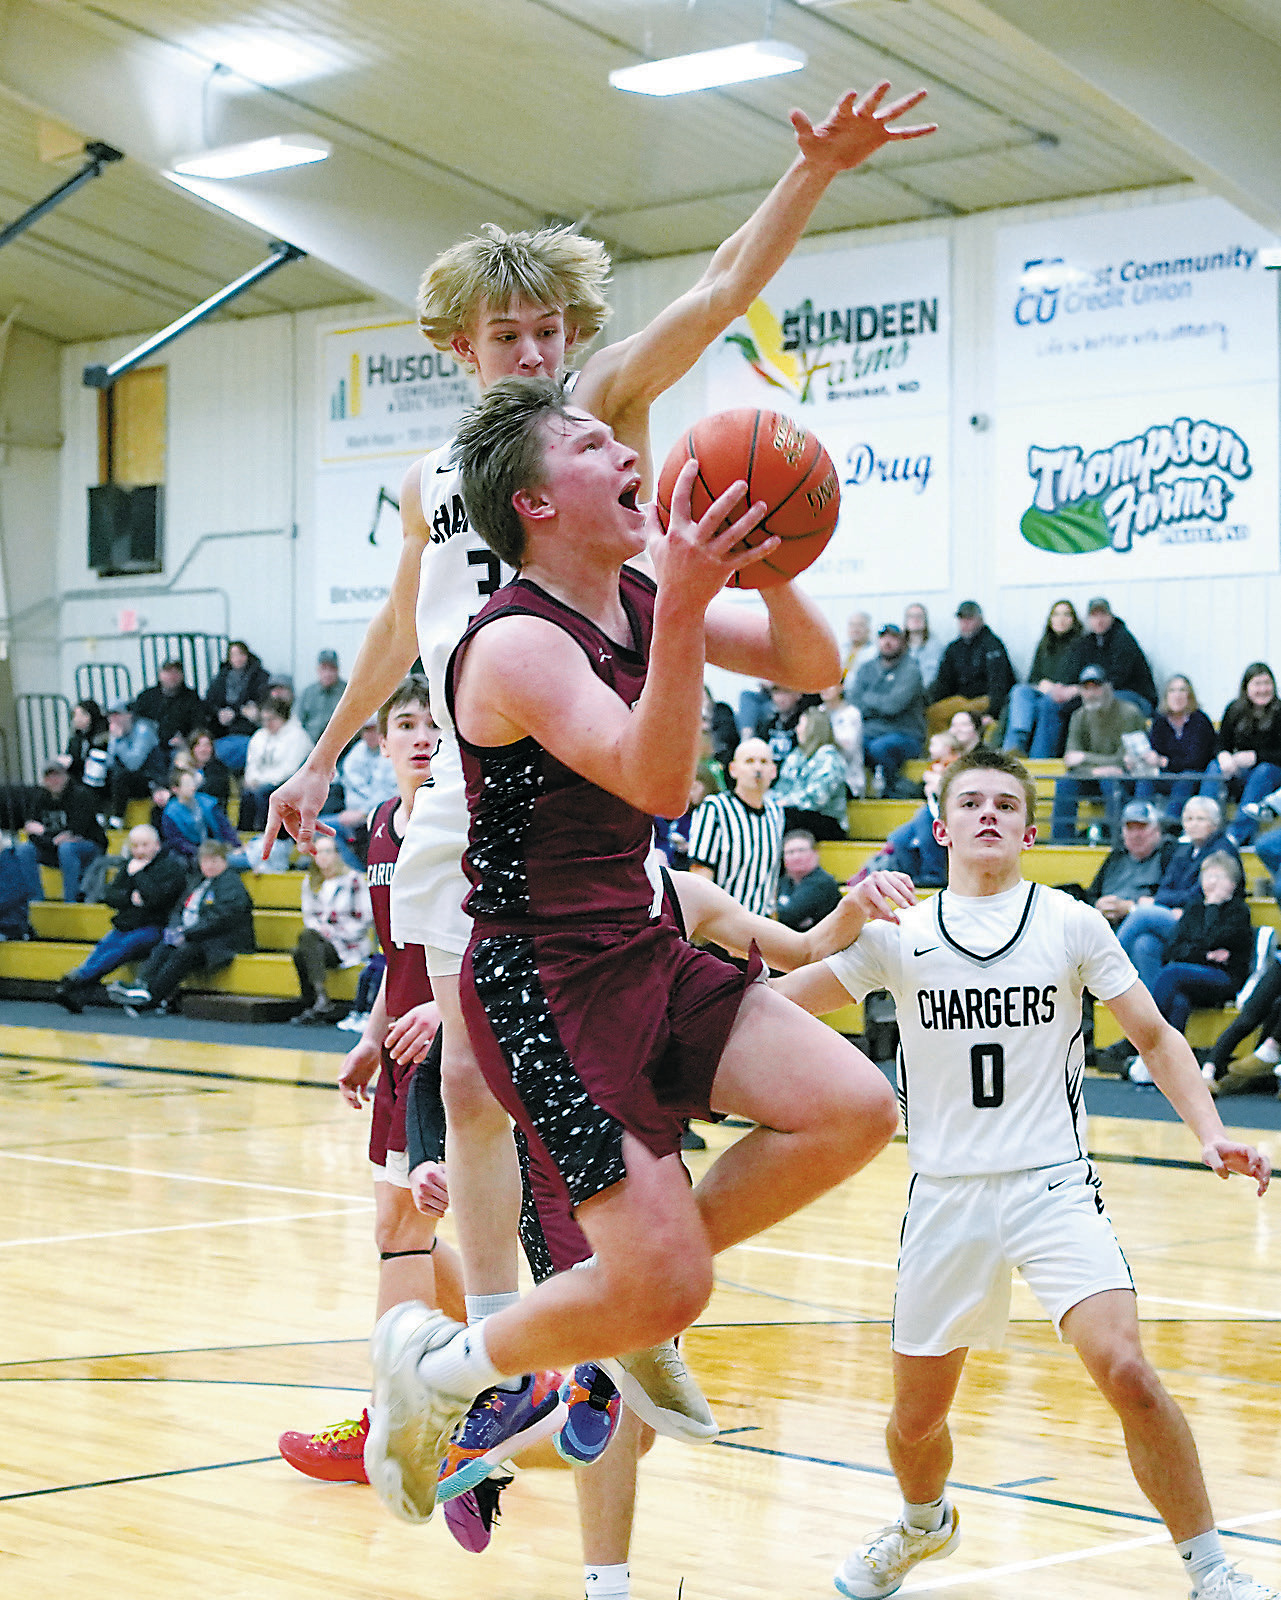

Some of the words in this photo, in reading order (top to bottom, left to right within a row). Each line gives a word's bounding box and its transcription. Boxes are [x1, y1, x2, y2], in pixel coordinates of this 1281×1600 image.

[1119, 245, 1257, 282] Community
[782, 298, 938, 351] SUNDEEN
[845, 442, 935, 495] Drug
[1027, 416, 1252, 515] Thompson
[1104, 473, 1234, 553] Farms
[917, 984, 1058, 1031] CHARGERS
[969, 1042, 1005, 1110] 0
